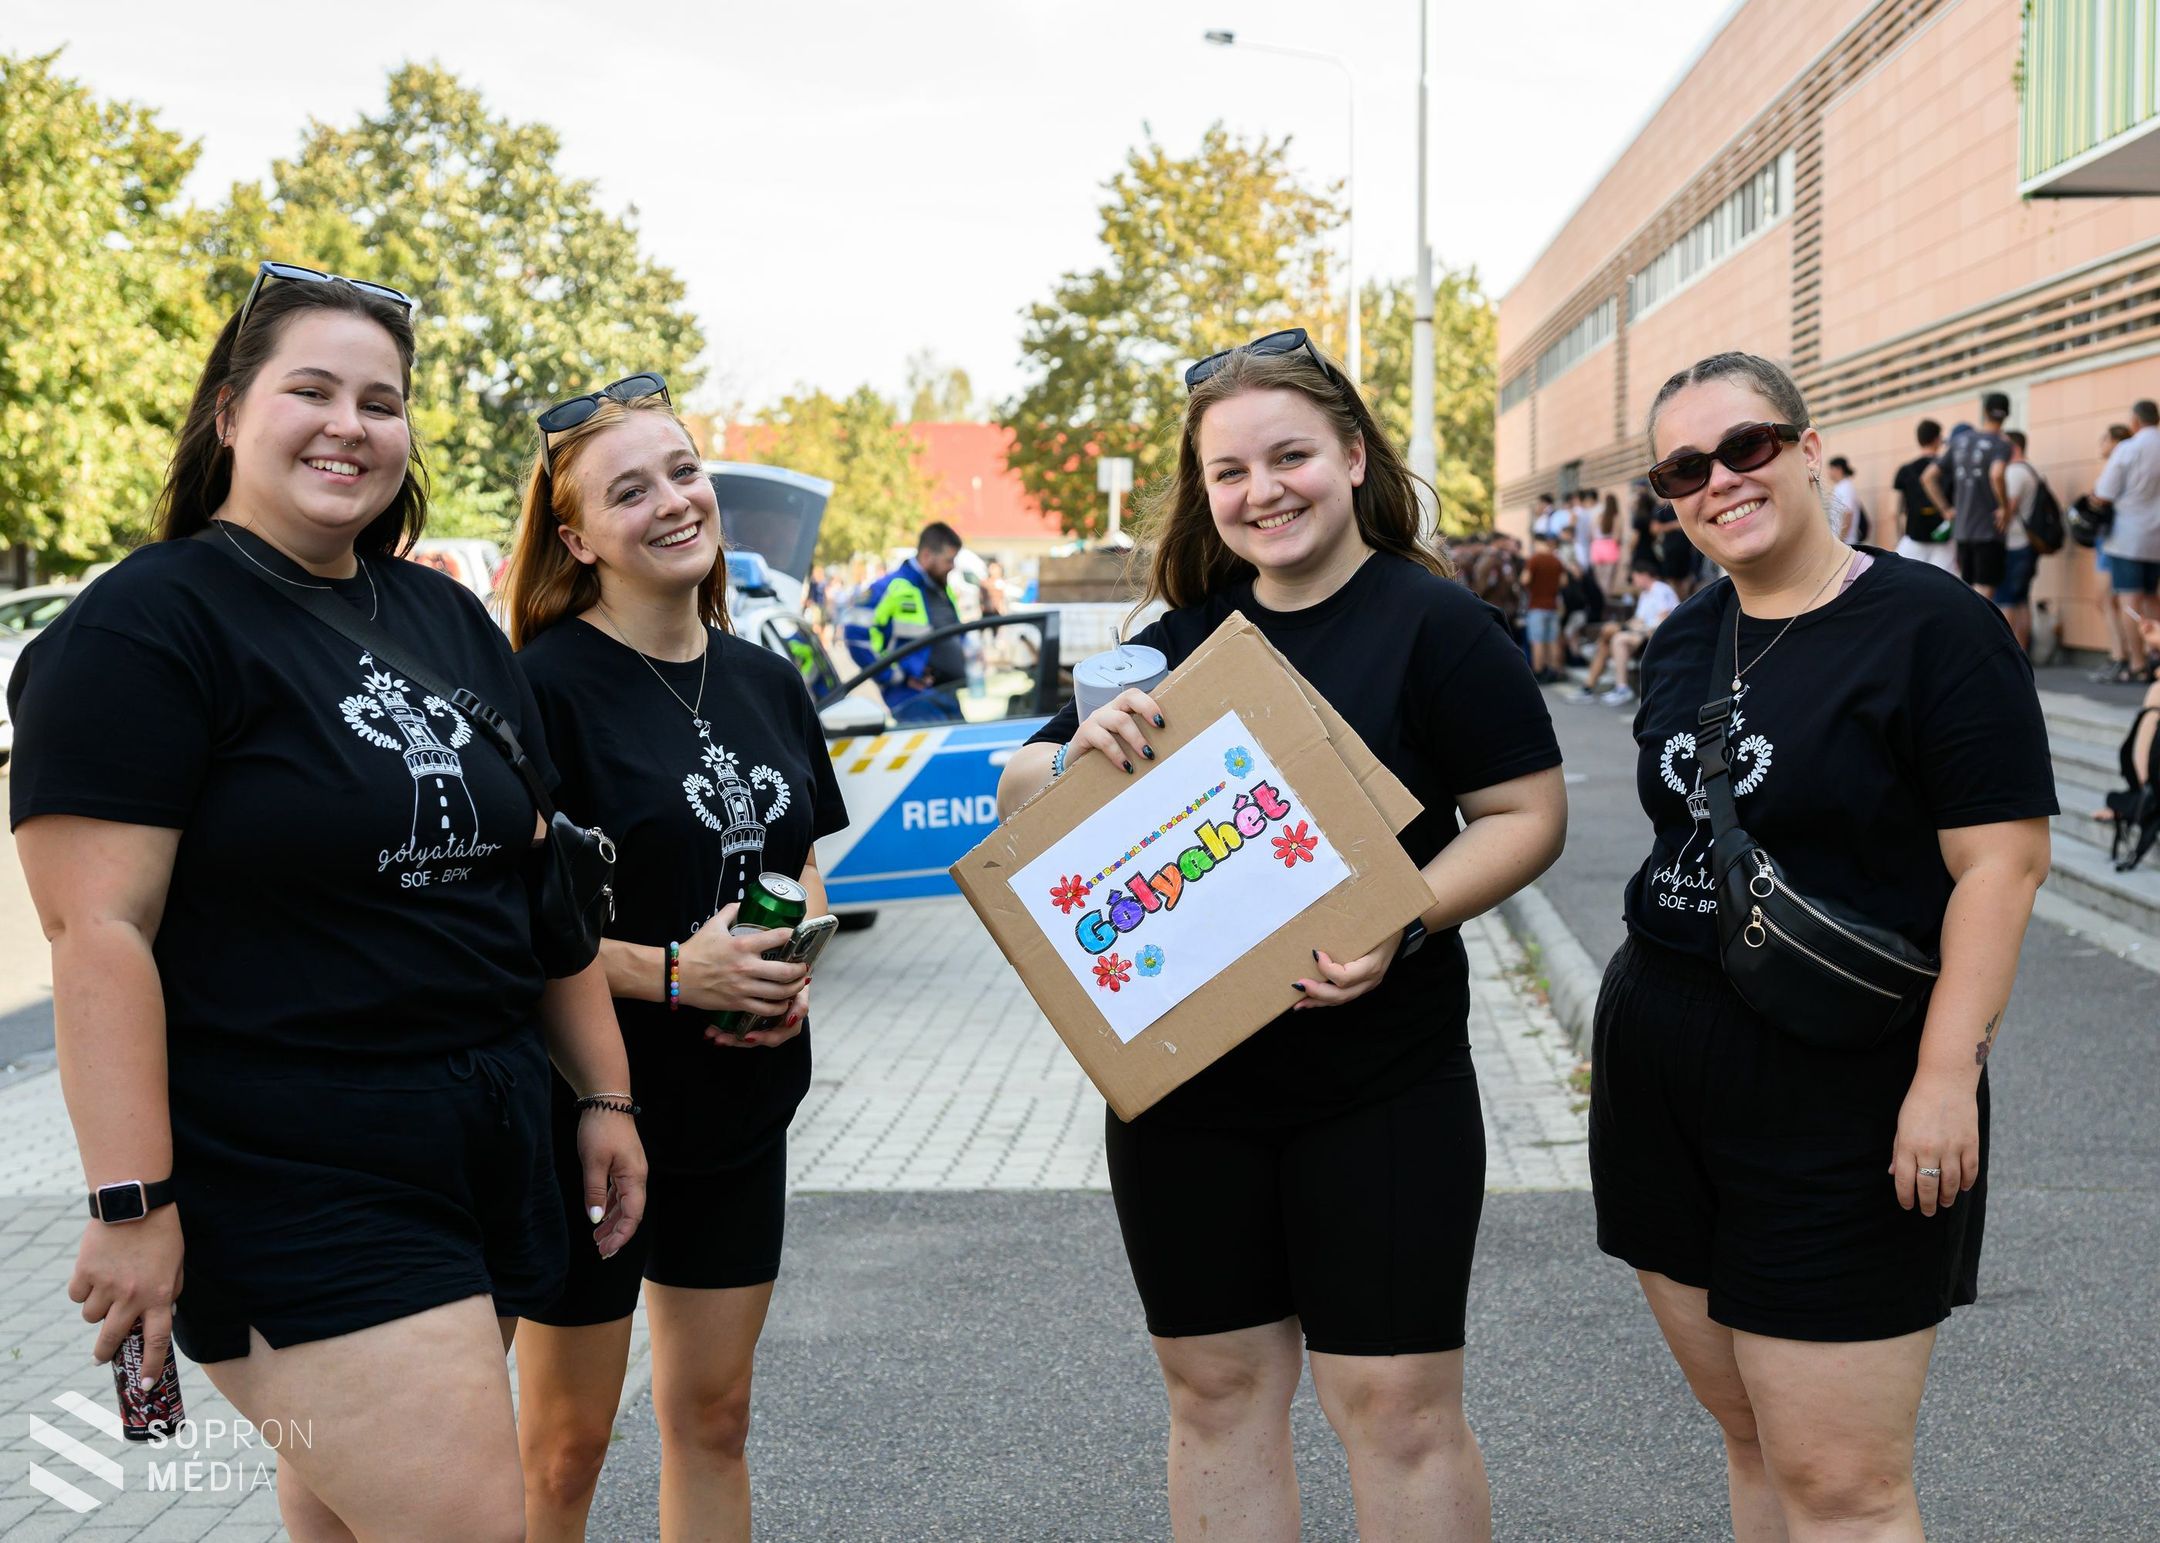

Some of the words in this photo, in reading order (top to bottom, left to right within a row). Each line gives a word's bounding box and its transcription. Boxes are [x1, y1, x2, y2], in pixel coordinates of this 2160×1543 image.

[901, 795, 998, 831] REND
[378, 832, 502, 872] gólyatábor
[1075, 779, 1291, 955] Gólyahét
[1102, 845, 1142, 876] Benedek
[1140, 830, 1162, 848] Elek
[400, 870, 432, 888] SOE
[441, 867, 473, 883] BPK
[1658, 893, 1688, 910] SOE
[1697, 899, 1718, 914] BP
[122, 1337, 137, 1392] FOOTBAL
